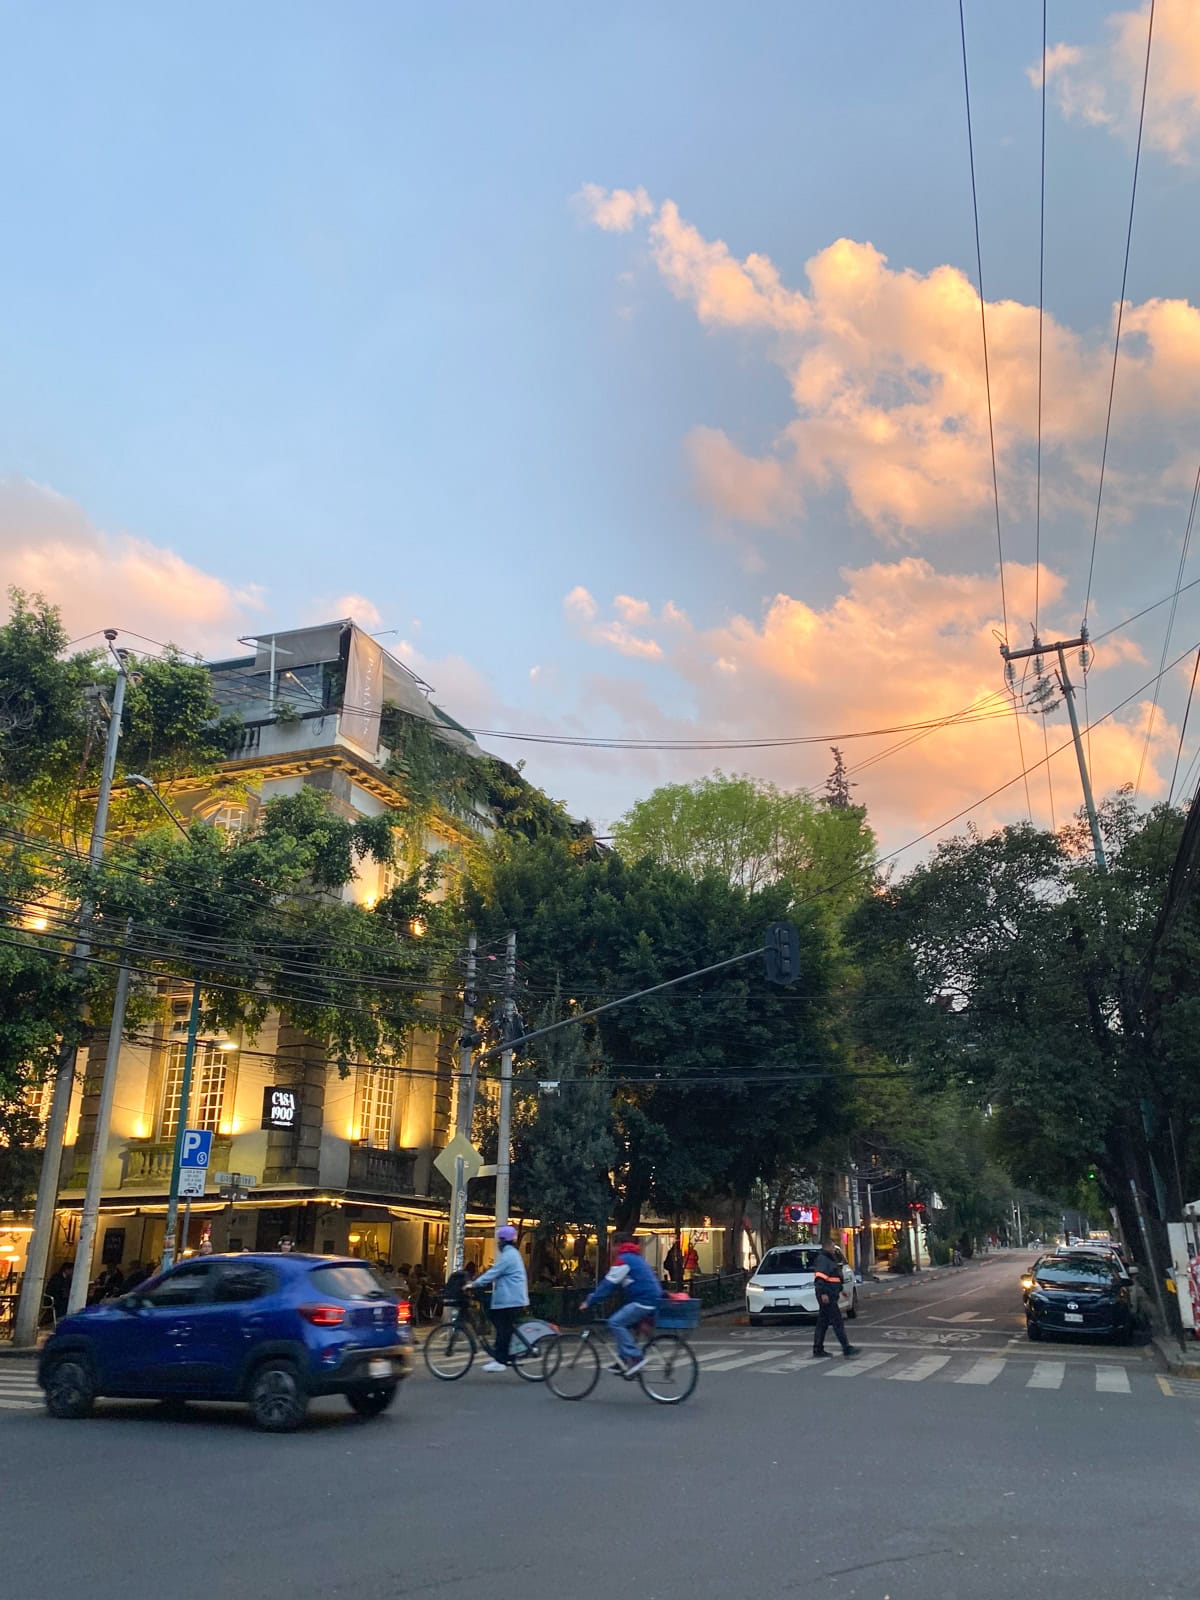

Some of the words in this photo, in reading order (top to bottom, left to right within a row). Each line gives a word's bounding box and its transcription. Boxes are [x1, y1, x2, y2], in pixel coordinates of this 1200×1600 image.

[271, 1091, 295, 1110] CASA
[271, 1106, 294, 1121] 1900
[183, 1132, 201, 1159] P
